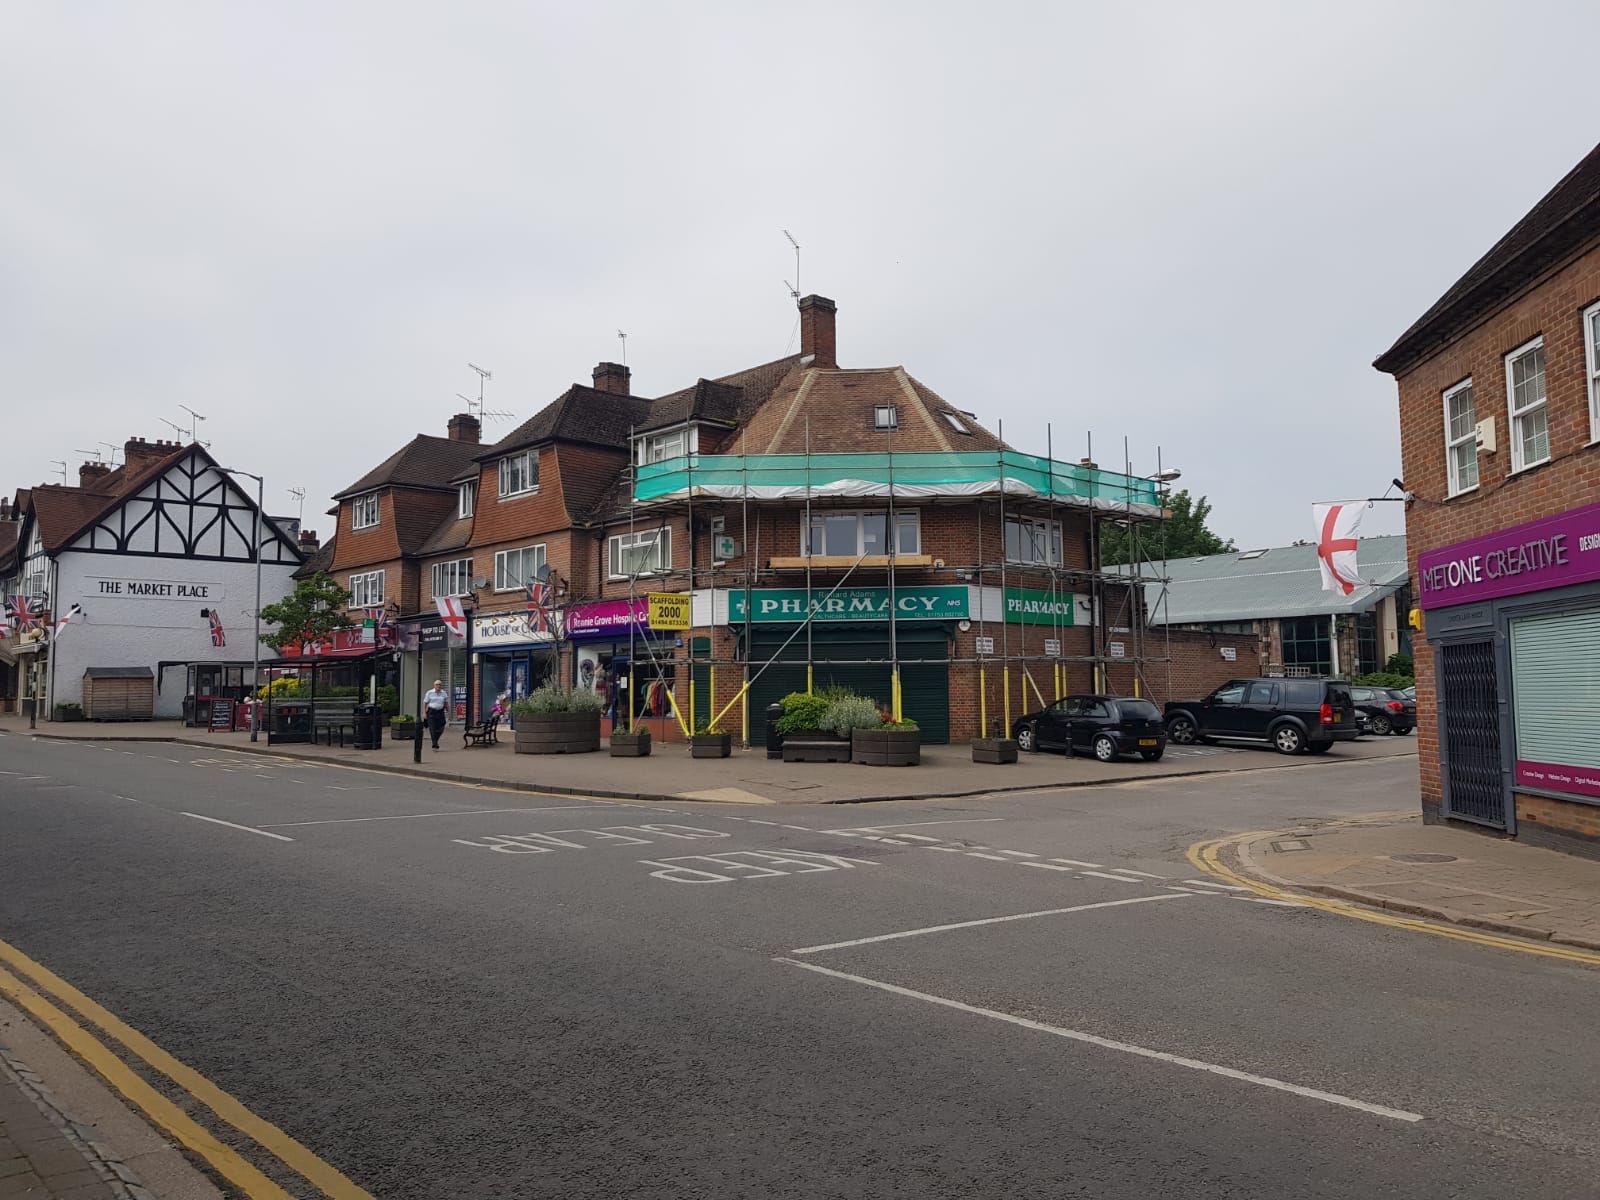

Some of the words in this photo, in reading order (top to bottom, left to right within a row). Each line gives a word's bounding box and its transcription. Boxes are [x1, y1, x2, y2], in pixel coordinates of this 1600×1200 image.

[1423, 555, 1482, 592] METONE
[1485, 533, 1569, 580] CREATIVE
[99, 581, 122, 593] THE
[128, 582, 173, 596] MARKET
[178, 585, 209, 598] PLACE
[650, 597, 689, 606] SCAFFOLDING
[760, 596, 941, 614] PHARMACY
[946, 599, 961, 607] NHS
[1007, 598, 1070, 615] PHARMACY
[594, 615, 612, 626] Grove
[659, 606, 681, 618] 2000
[481, 625, 511, 637] HOUSE
[451, 823, 732, 854] CLEAR
[637, 848, 882, 883] KEEP
